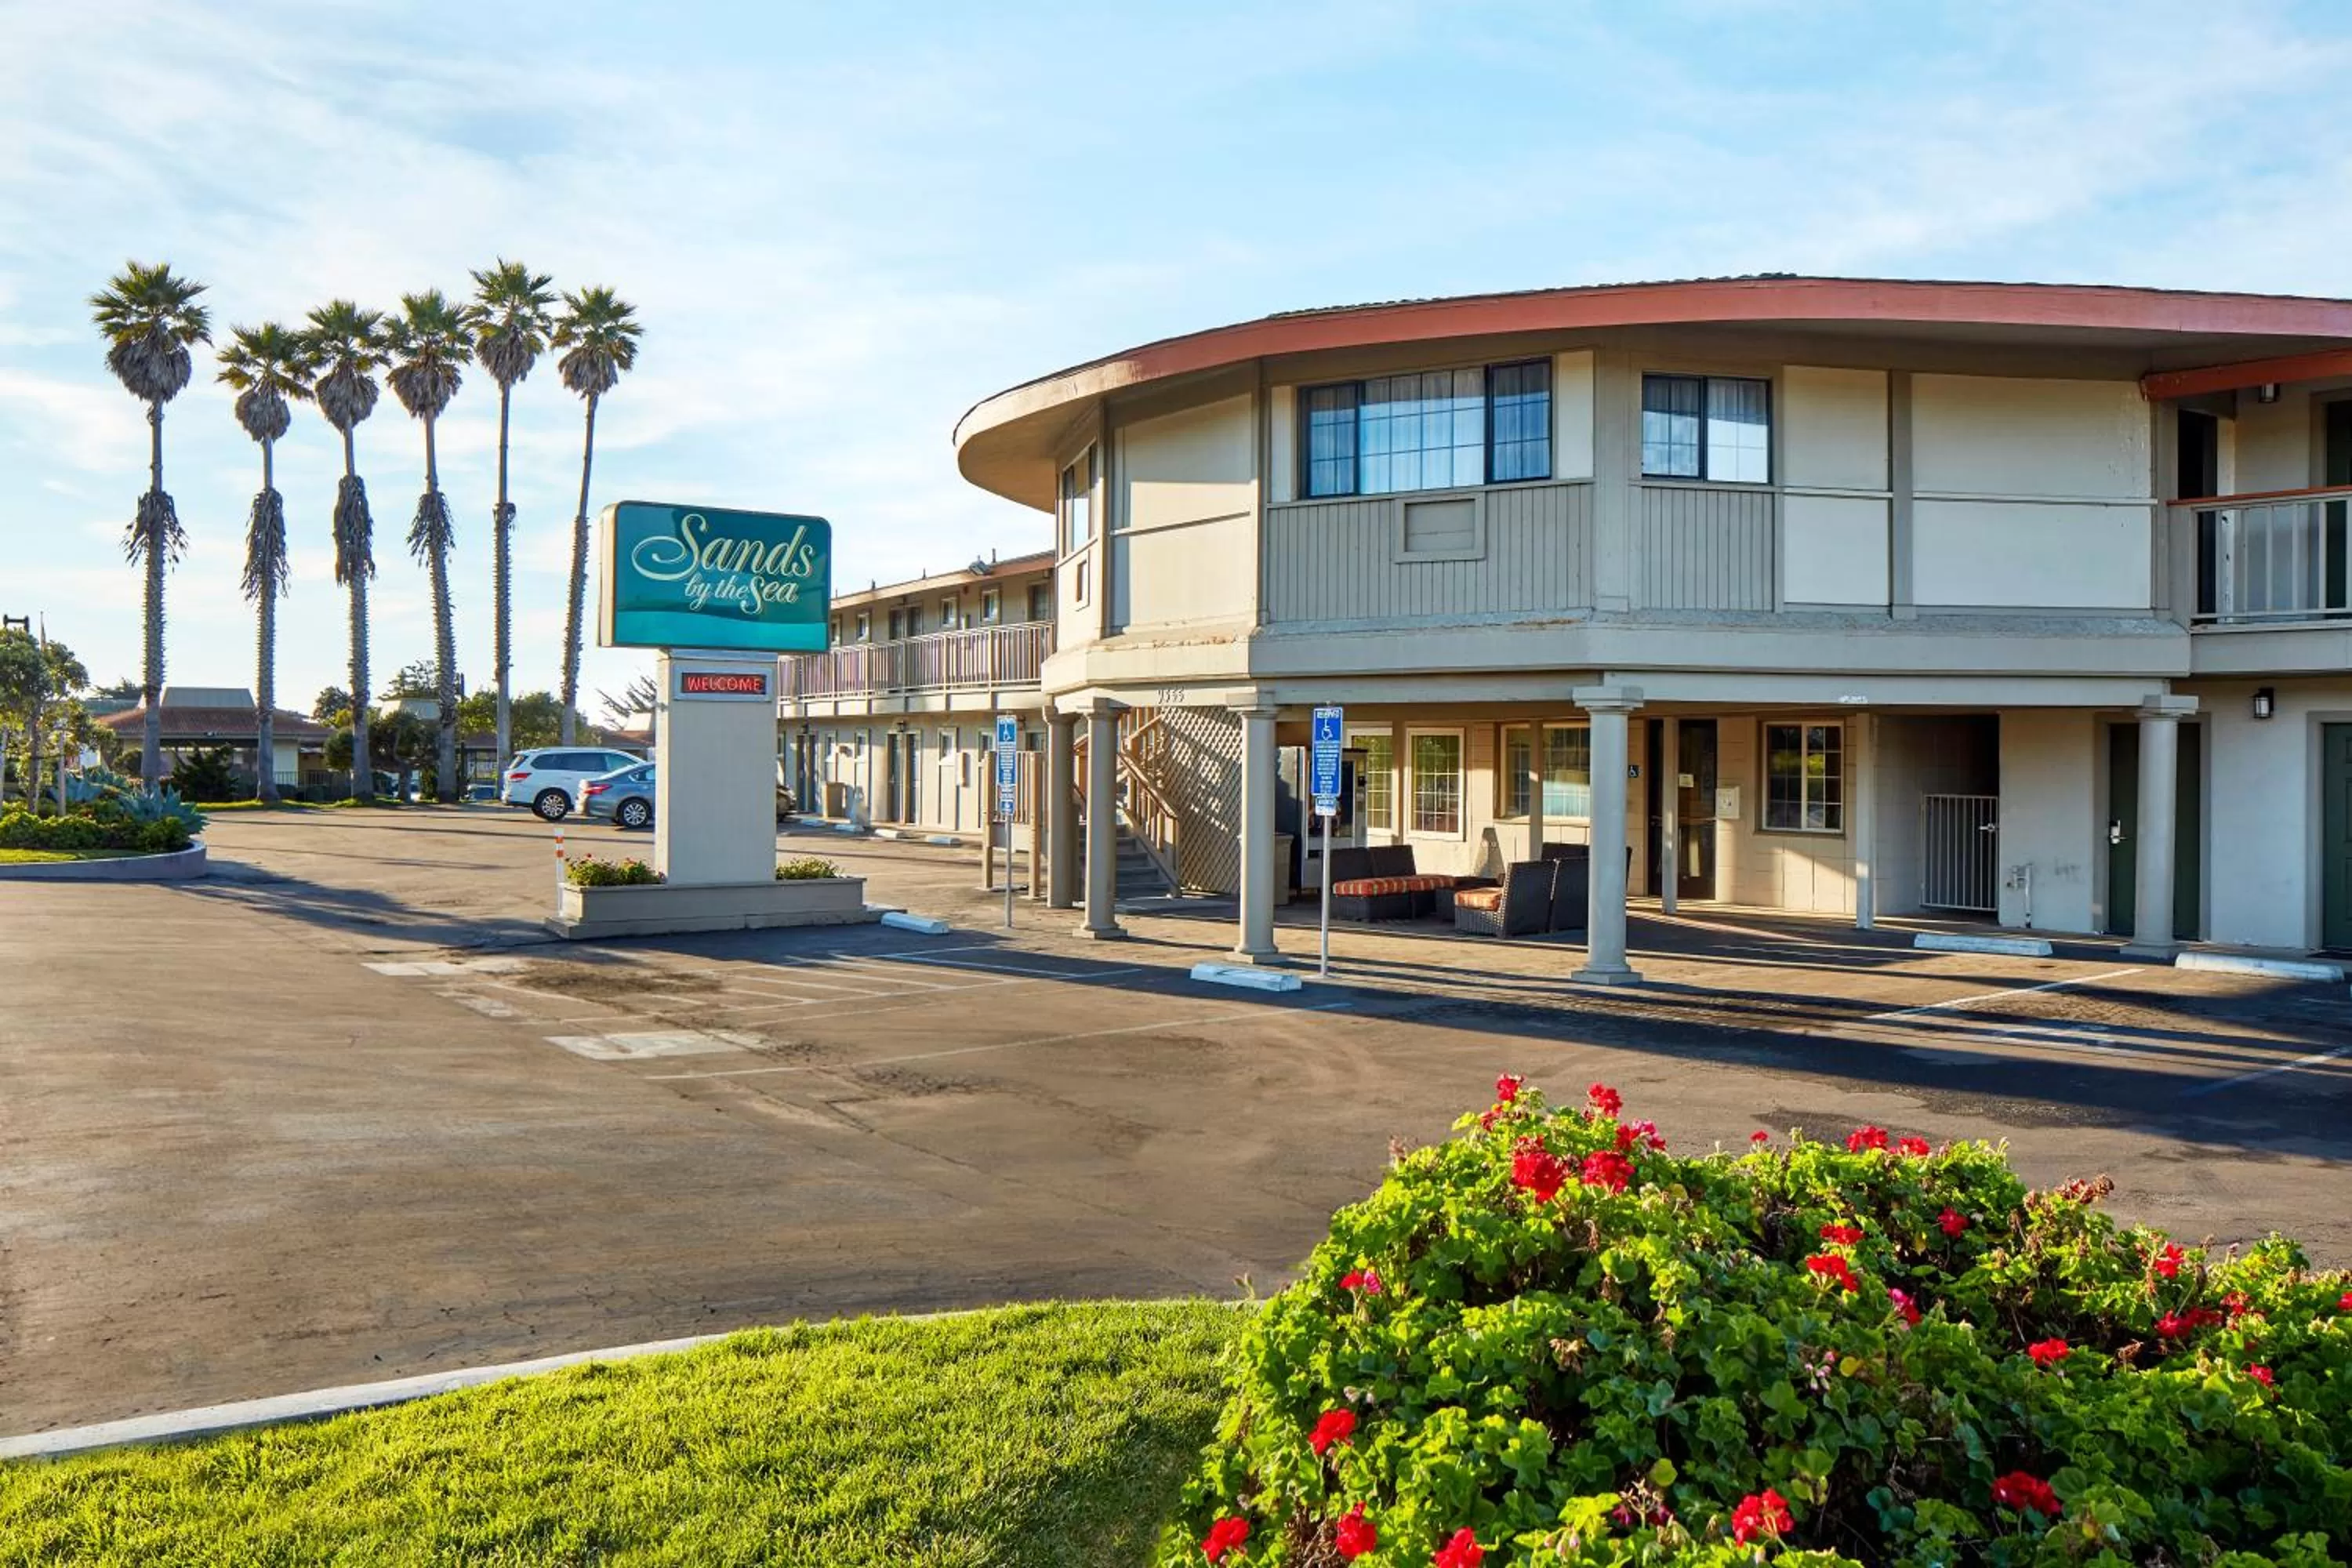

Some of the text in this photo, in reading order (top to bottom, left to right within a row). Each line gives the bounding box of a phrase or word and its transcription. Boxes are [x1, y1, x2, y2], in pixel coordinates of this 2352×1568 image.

[632, 514, 813, 580] Sands
[684, 574, 800, 615] by the Sea
[688, 677, 762, 691] WELCOME
